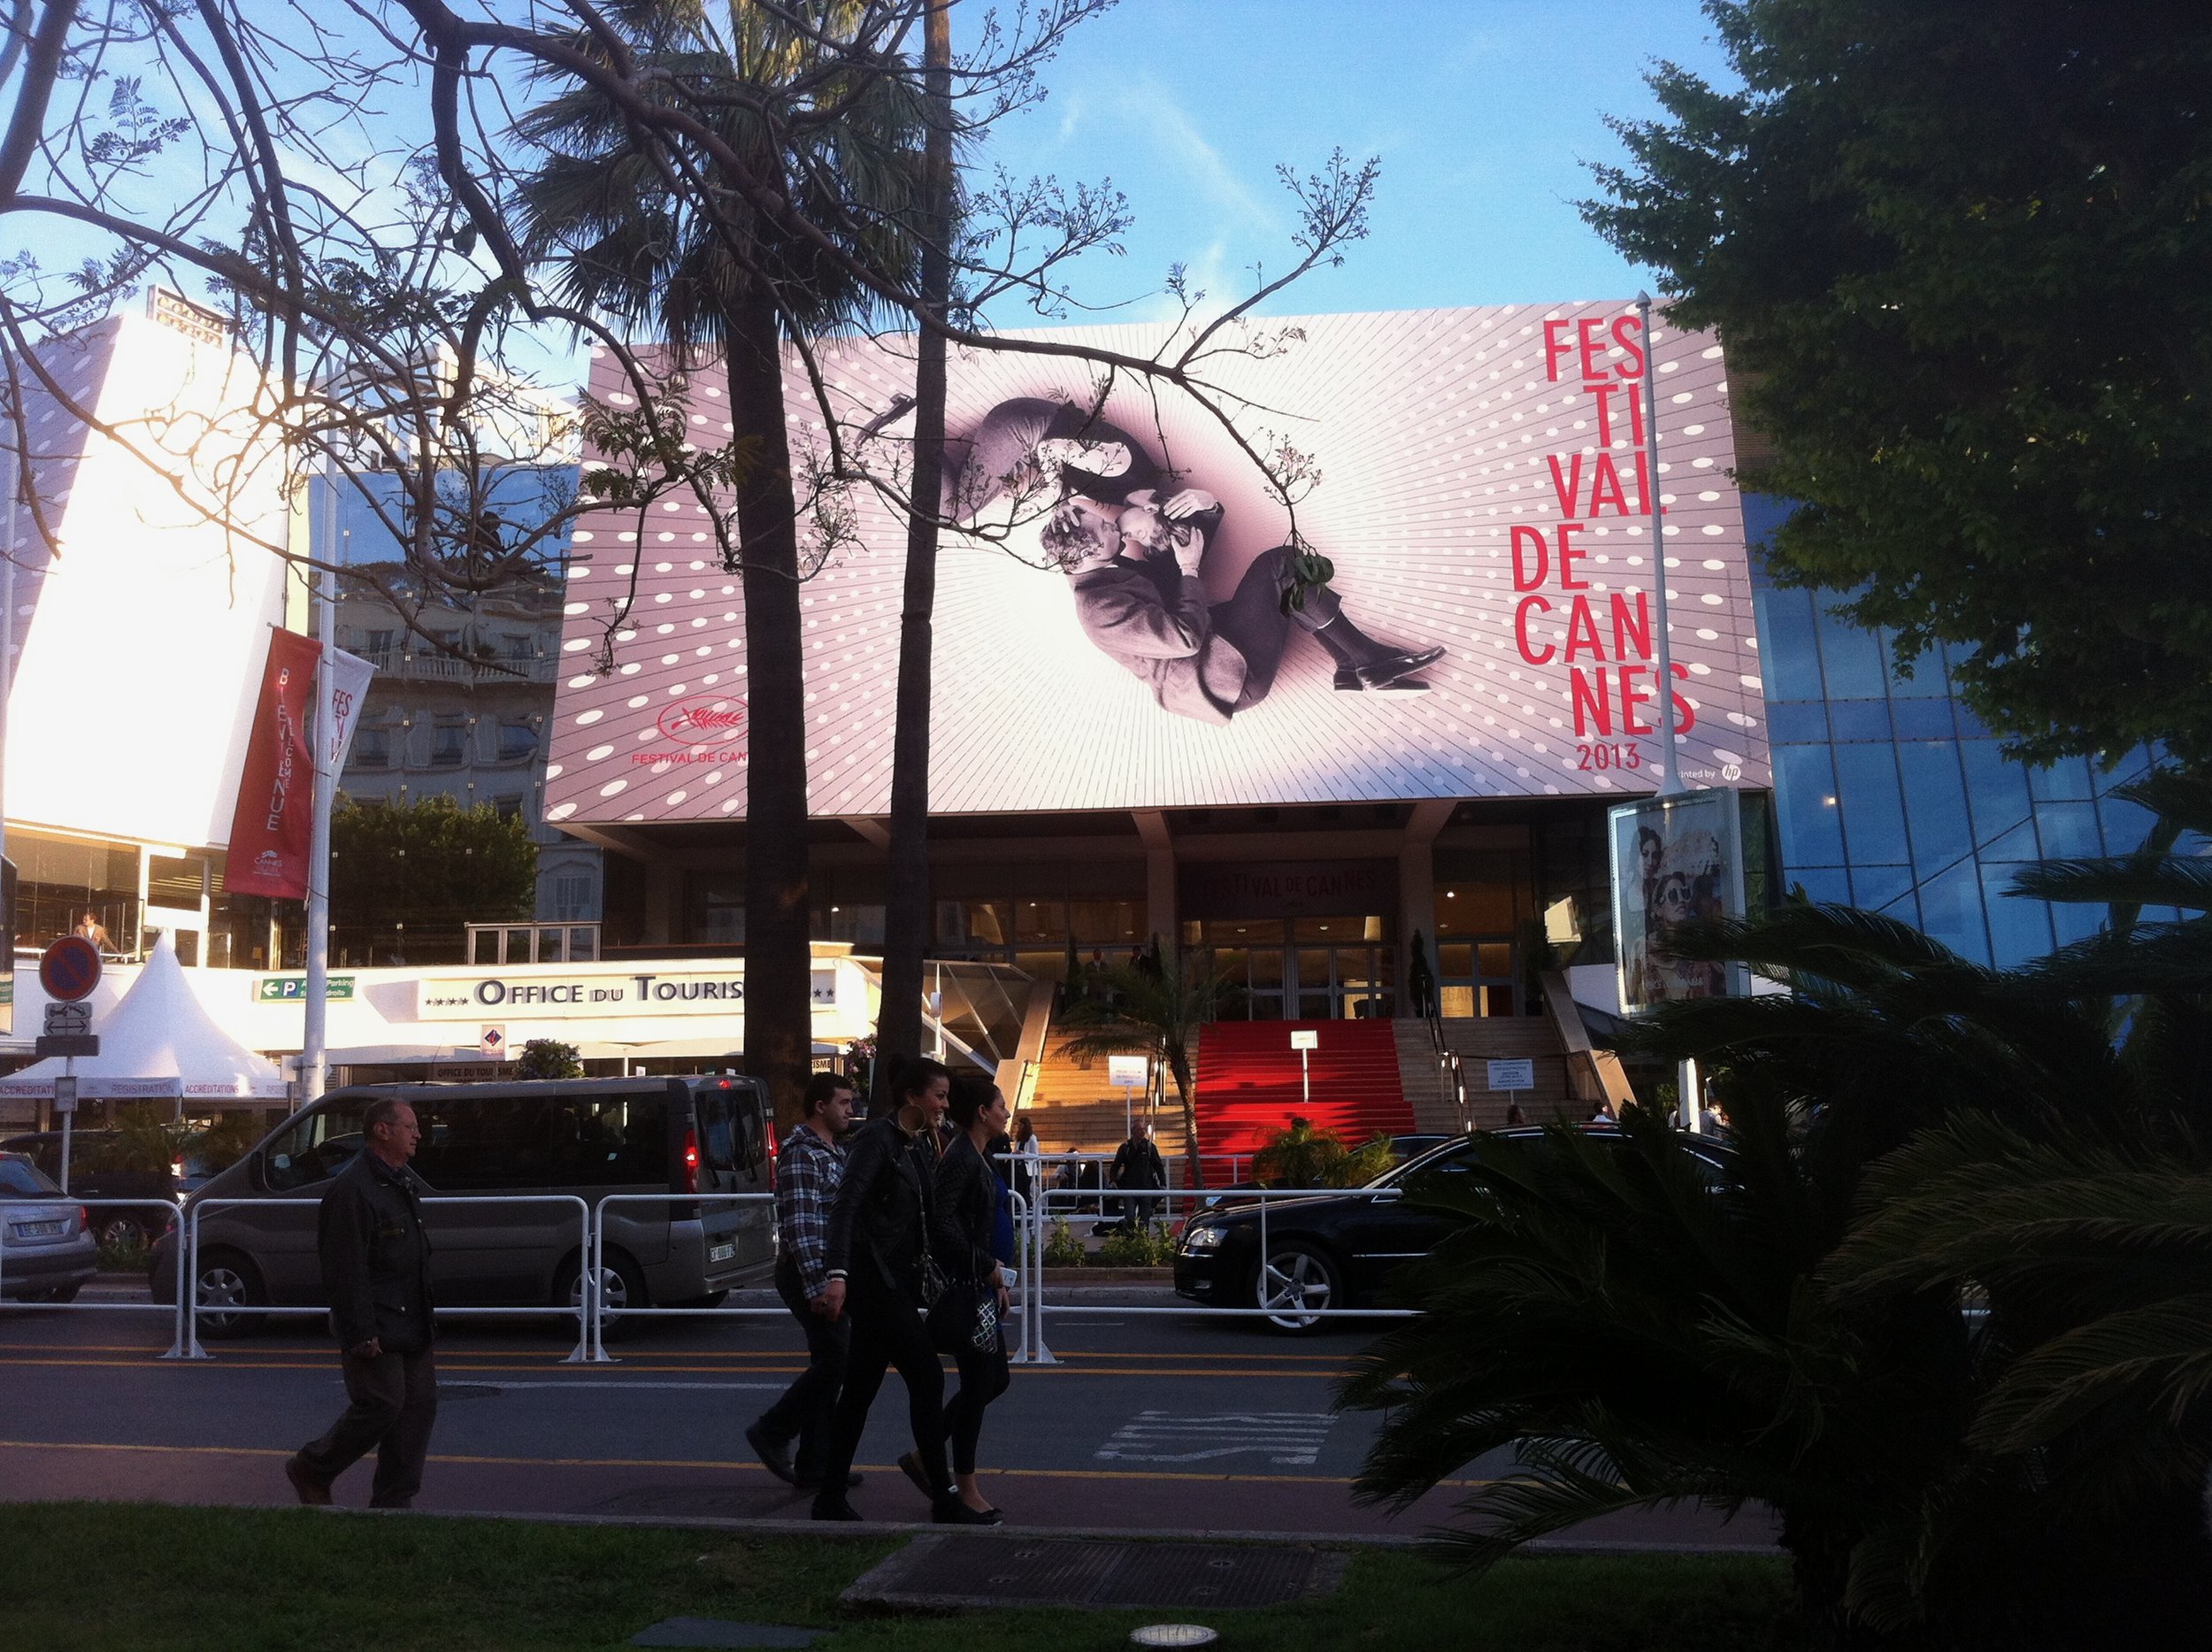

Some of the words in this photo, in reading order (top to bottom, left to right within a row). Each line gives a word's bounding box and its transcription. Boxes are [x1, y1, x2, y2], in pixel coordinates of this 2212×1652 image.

[1543, 315, 1645, 381] FES
[1583, 382, 1645, 448] TI
[1547, 450, 1667, 519] VAL
[1509, 522, 1589, 593] DE
[1514, 591, 1653, 665] CAN
[333, 688, 353, 717] FES
[1569, 662, 1696, 737] NES
[267, 667, 289, 832] BIENVENUE
[631, 752, 693, 765] FESTIVAL
[695, 752, 715, 763] DE
[719, 751, 748, 763] CAN
[1577, 742, 1641, 772] 2013
[1704, 770, 1716, 780] by
[1724, 764, 1740, 781] hp
[283, 981, 296, 996] P
[476, 980, 584, 1005] OFFICE
[593, 988, 624, 1002] DU
[633, 975, 743, 1002] TOURIS
[0, 1085, 55, 1095] ACCREDITATI
